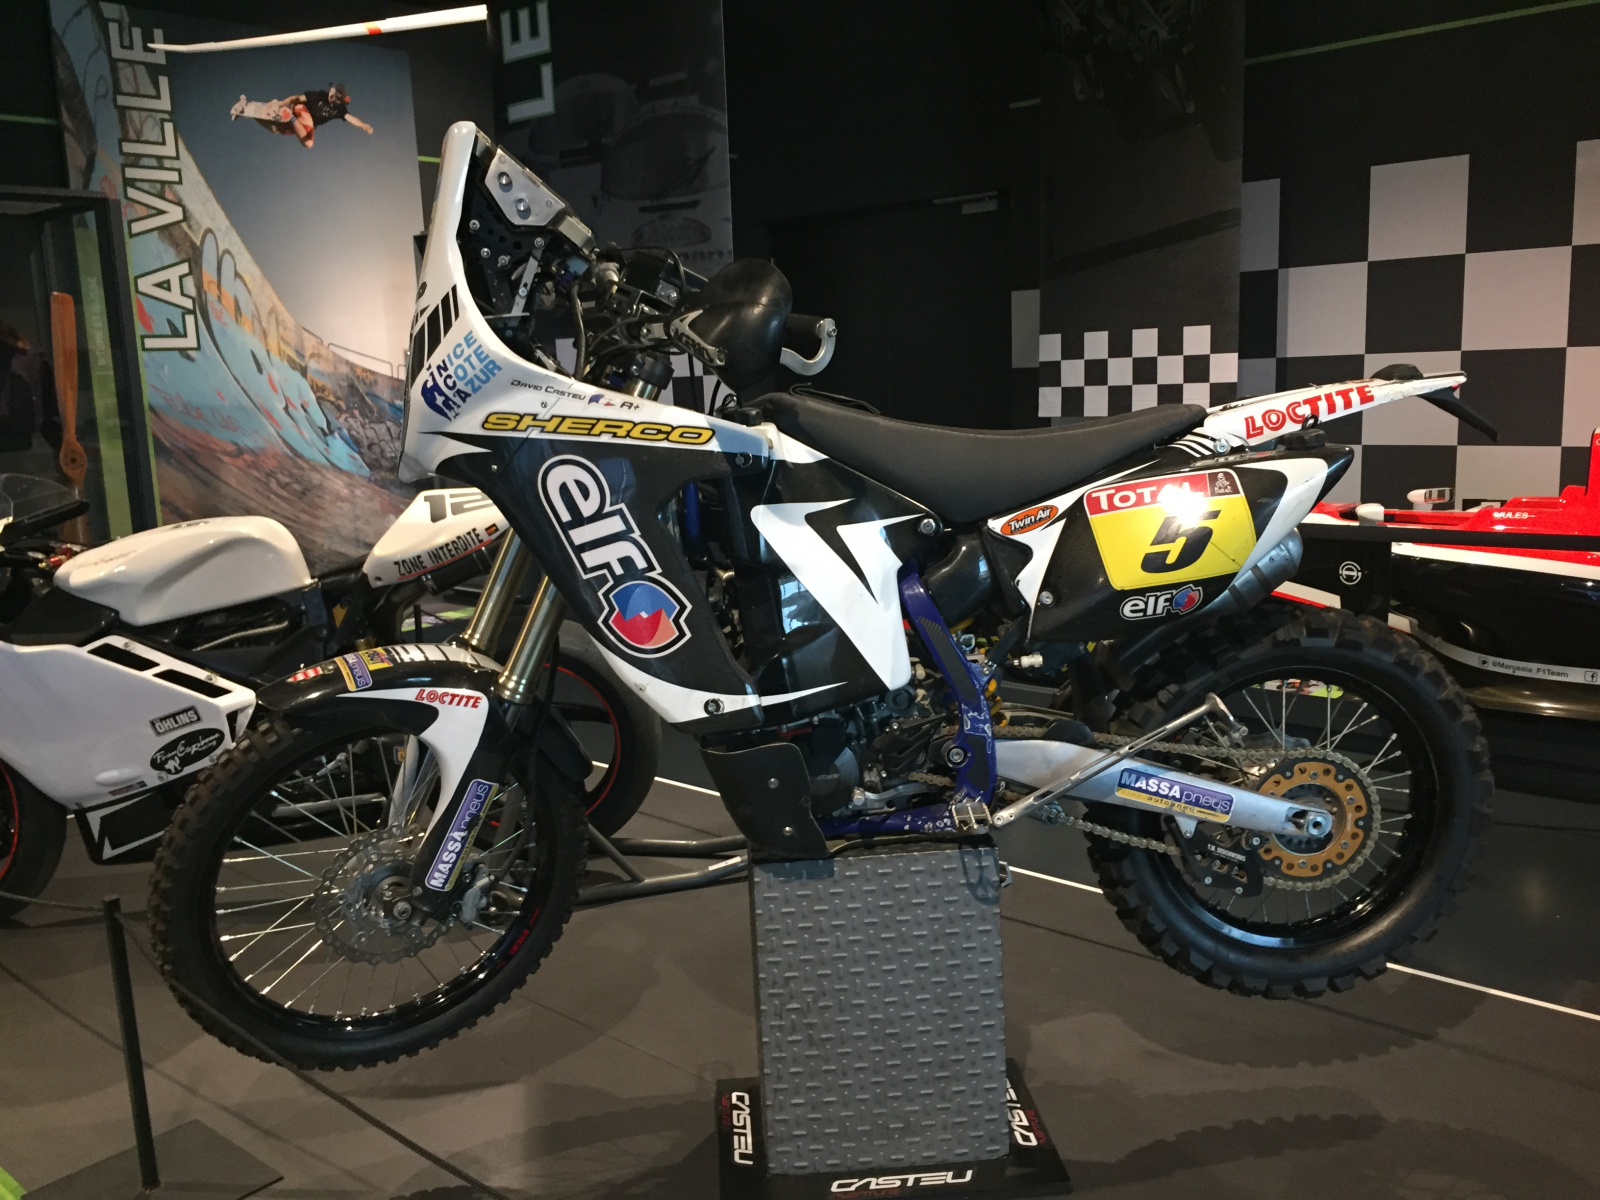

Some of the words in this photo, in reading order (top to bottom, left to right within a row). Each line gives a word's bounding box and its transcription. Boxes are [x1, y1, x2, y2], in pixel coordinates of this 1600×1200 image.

[499, 0, 555, 124] LE
[107, 20, 184, 237] VILLE
[136, 259, 200, 352] LA
[436, 330, 477, 378] NICE
[443, 344, 490, 391] COTE
[481, 411, 716, 446] SHERCO
[1244, 384, 1375, 439] LOCTITE
[423, 491, 494, 524] 12
[543, 460, 653, 577] elf
[1008, 514, 1035, 532] Twin
[1035, 507, 1053, 521] Air
[393, 553, 427, 577] ZONE
[427, 527, 484, 564] INTERDITE
[1139, 508, 1222, 574] 5
[1121, 592, 1173, 619] elf
[413, 688, 485, 710] LOCTITE
[1120, 771, 1181, 799] MASSA
[1182, 790, 1231, 813] pneus
[429, 829, 469, 889] MASSA
[731, 1091, 754, 1165] CASTEU
[830, 1169, 974, 1193] CASTEU
